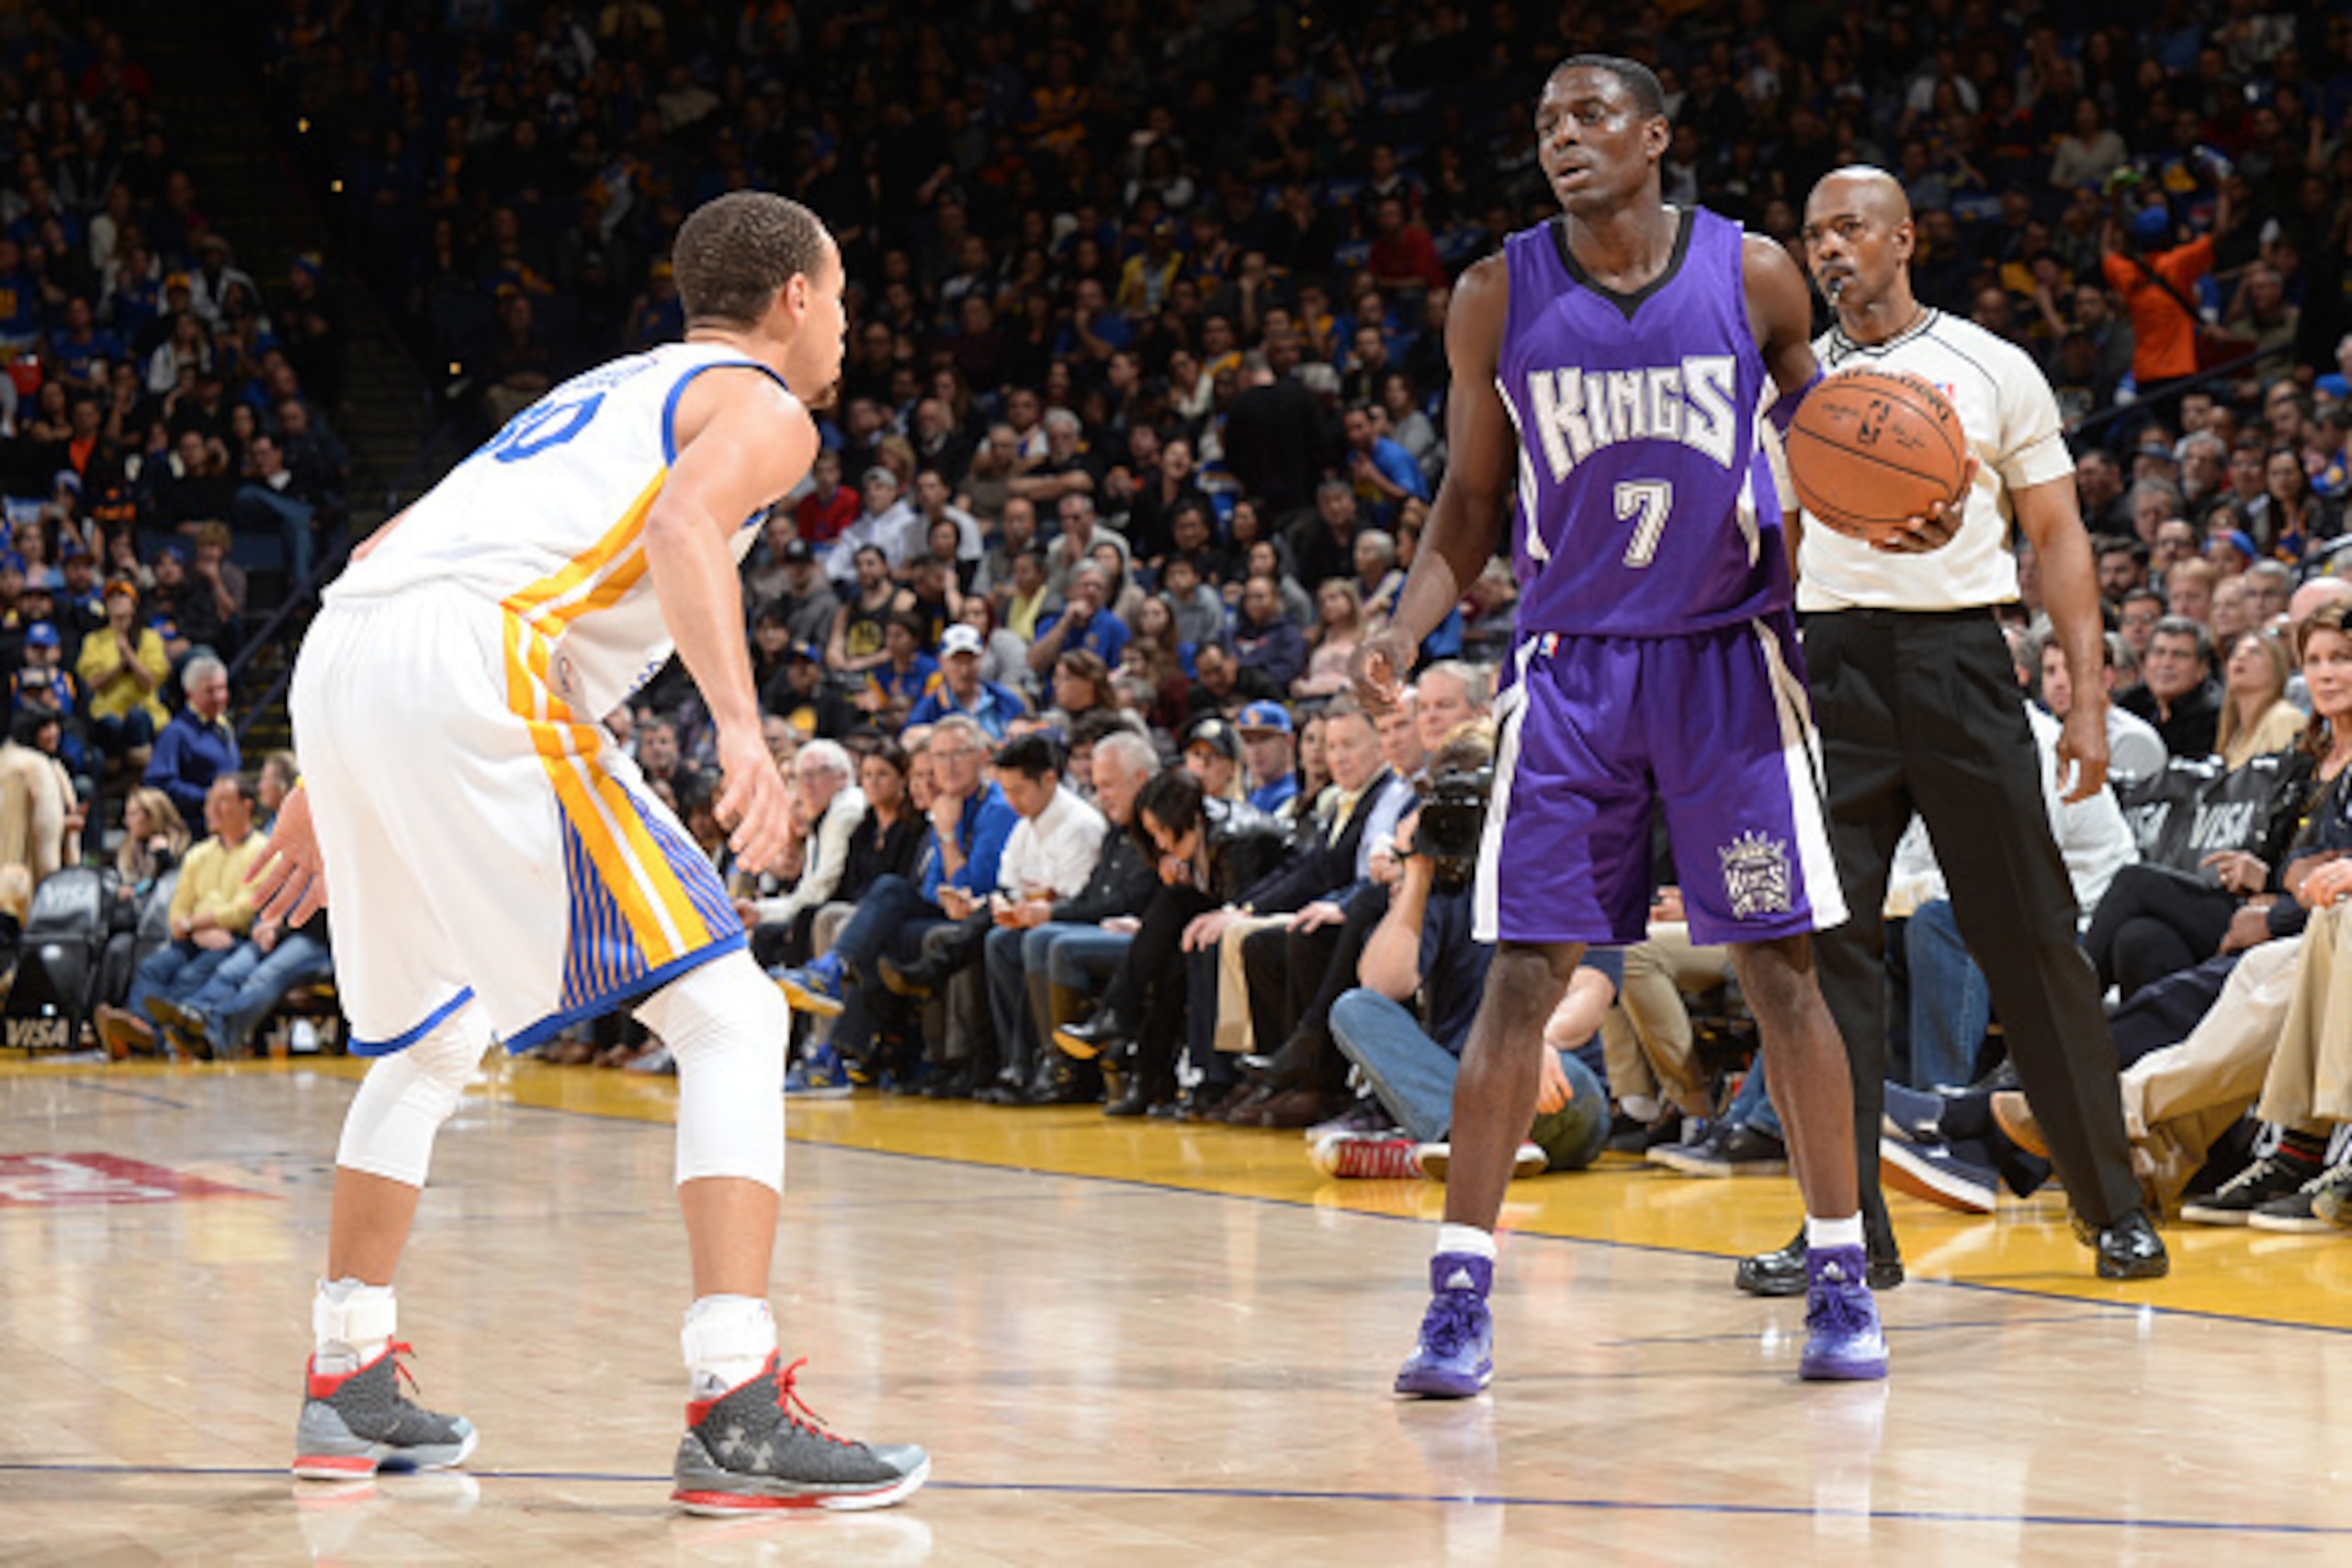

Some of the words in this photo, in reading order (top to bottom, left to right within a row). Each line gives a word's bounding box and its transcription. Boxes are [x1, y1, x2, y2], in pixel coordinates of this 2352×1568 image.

[1527, 355, 1736, 484] KINGS
[1613, 479, 1673, 569] 7
[2188, 800, 2256, 850] VISA
[5, 1018, 71, 1047] VISA
